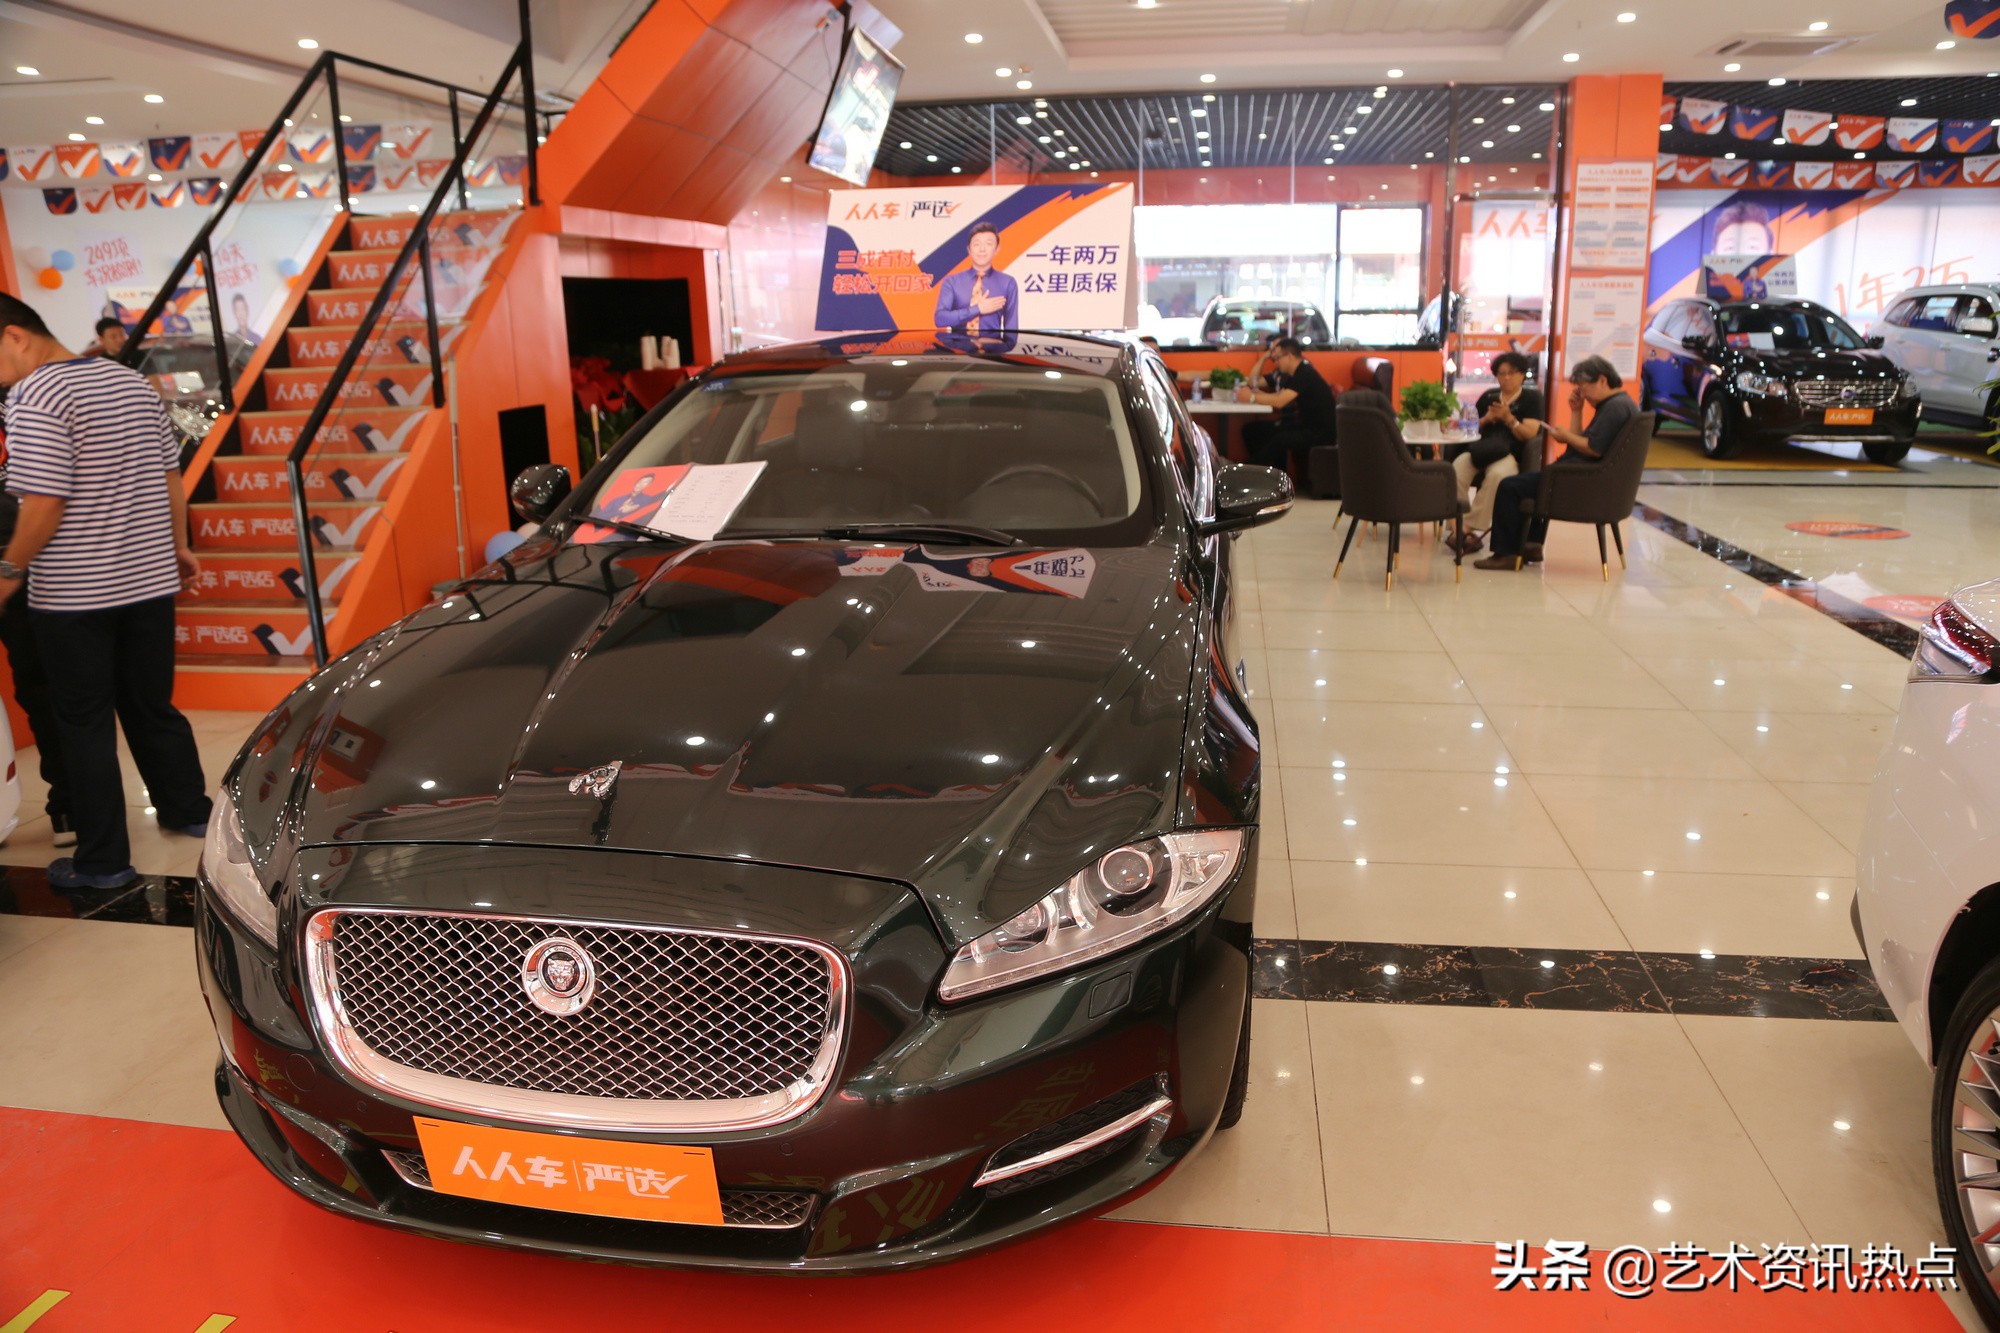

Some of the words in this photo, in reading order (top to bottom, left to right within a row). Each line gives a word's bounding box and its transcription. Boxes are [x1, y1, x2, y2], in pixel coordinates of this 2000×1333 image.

[844, 202, 901, 220] 人人车
[911, 200, 962, 218] 严选
[360, 229, 400, 247] 人人车
[835, 249, 916, 270] 三成首付
[1026, 245, 1120, 266] 一年两万
[338, 263, 380, 281] 人人车
[832, 273, 934, 295] 轻松开回家
[1024, 273, 1118, 294] 公里质保
[317, 302, 360, 320] 人人车
[297, 340, 339, 359] 人人车
[275, 382, 318, 401] 人人车
[250, 426, 294, 445] 人人车
[299, 425, 348, 443] 选店
[224, 471, 270, 491] 人人车
[275, 471, 326, 489] 严店
[201, 518, 246, 537] 人人车
[223, 569, 276, 588] 严选店
[196, 625, 249, 644] 严选店
[452, 1145, 568, 1188] 人人车
[581, 1162, 688, 1199] 严选
